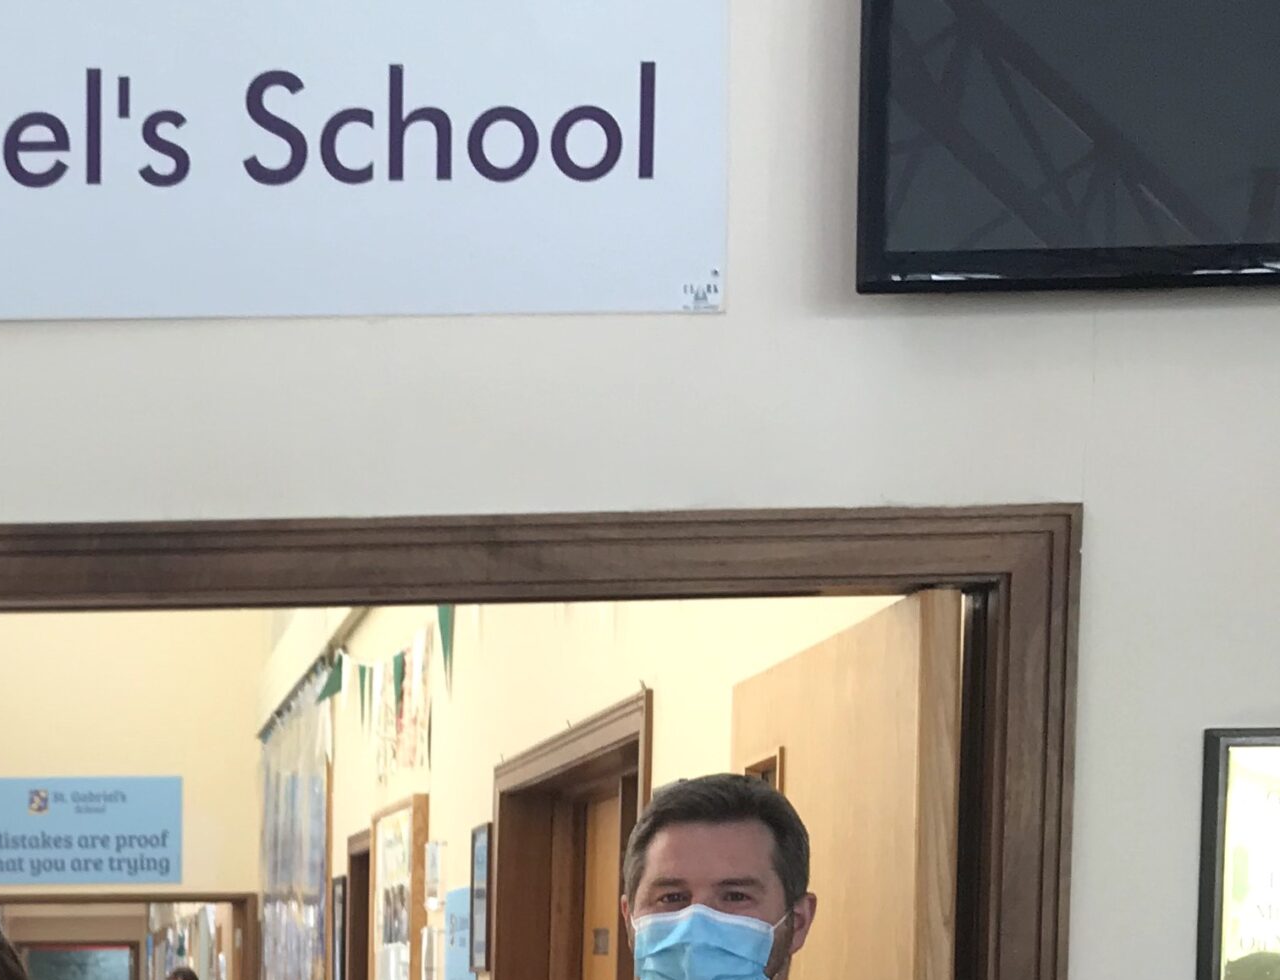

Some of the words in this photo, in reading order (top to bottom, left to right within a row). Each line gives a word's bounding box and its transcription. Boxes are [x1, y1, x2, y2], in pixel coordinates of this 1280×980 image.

[242, 61, 657, 187] School
[77, 835, 110, 849] are
[115, 830, 170, 852] proof
[29, 858, 66, 877] you
[70, 858, 104, 873] are
[108, 854, 171, 876] trying
